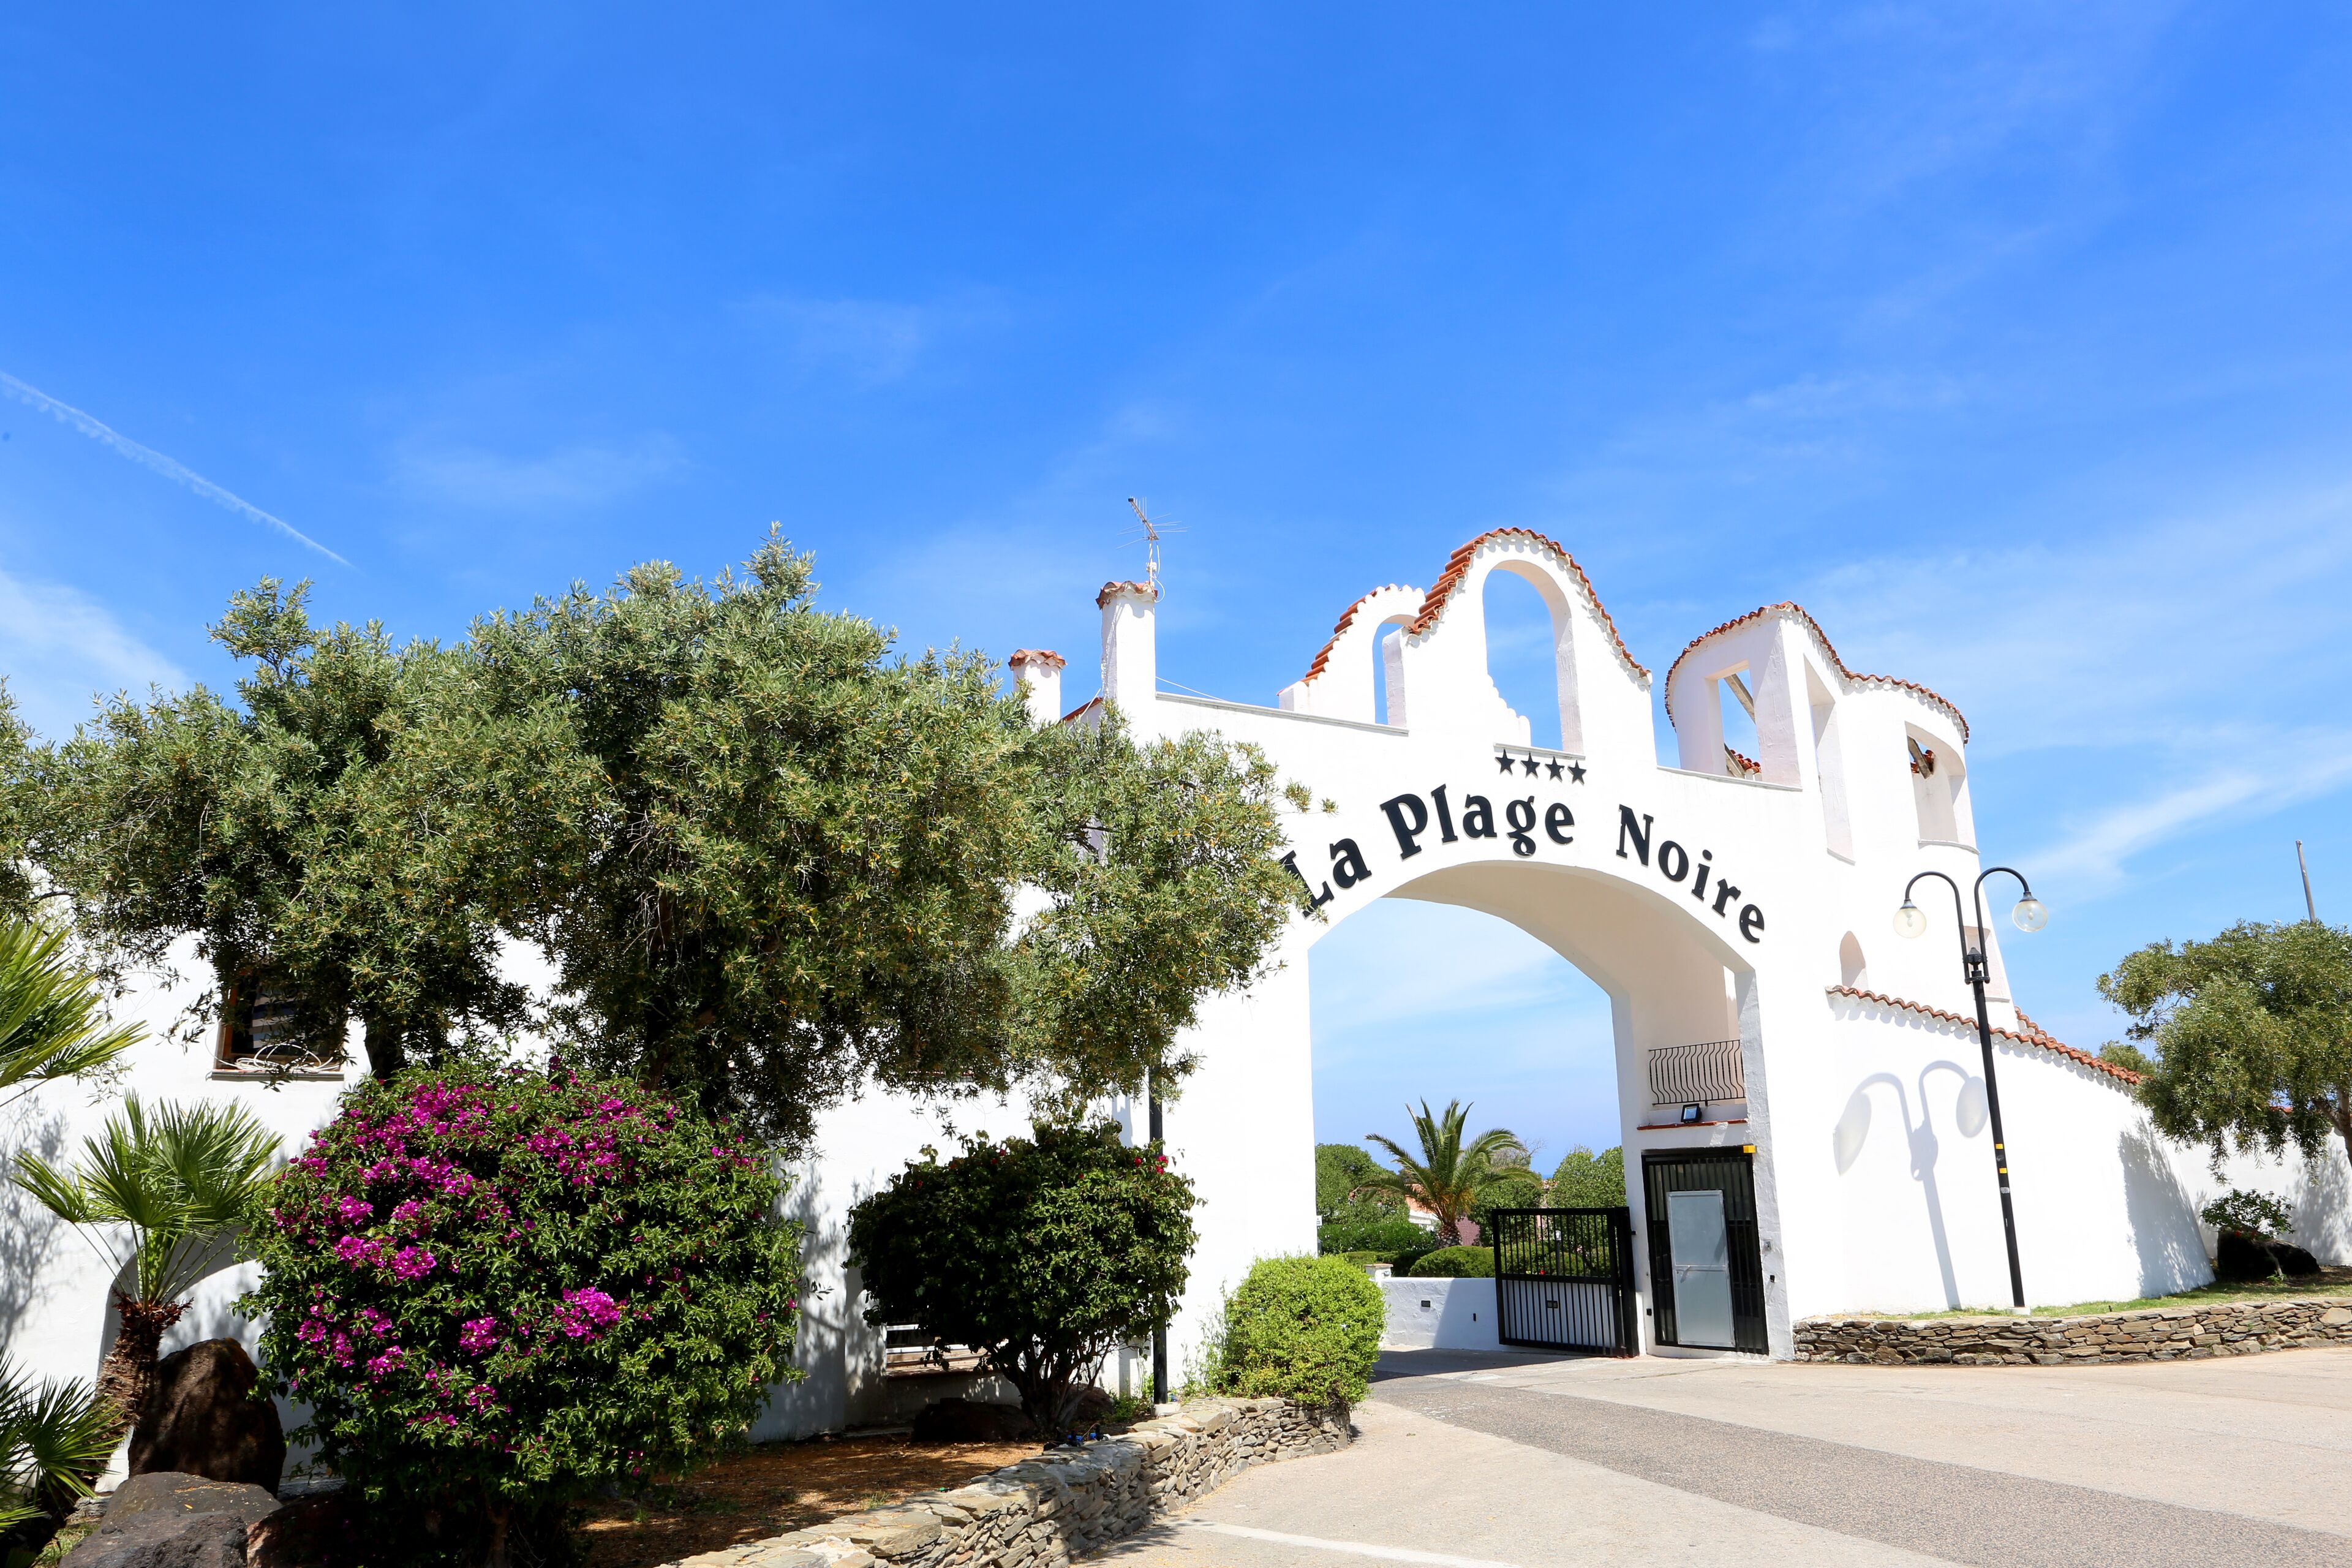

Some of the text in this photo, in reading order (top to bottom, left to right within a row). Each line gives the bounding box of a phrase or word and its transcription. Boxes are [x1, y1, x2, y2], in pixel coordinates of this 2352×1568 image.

[1280, 784, 1765, 943] La Plage Noire
